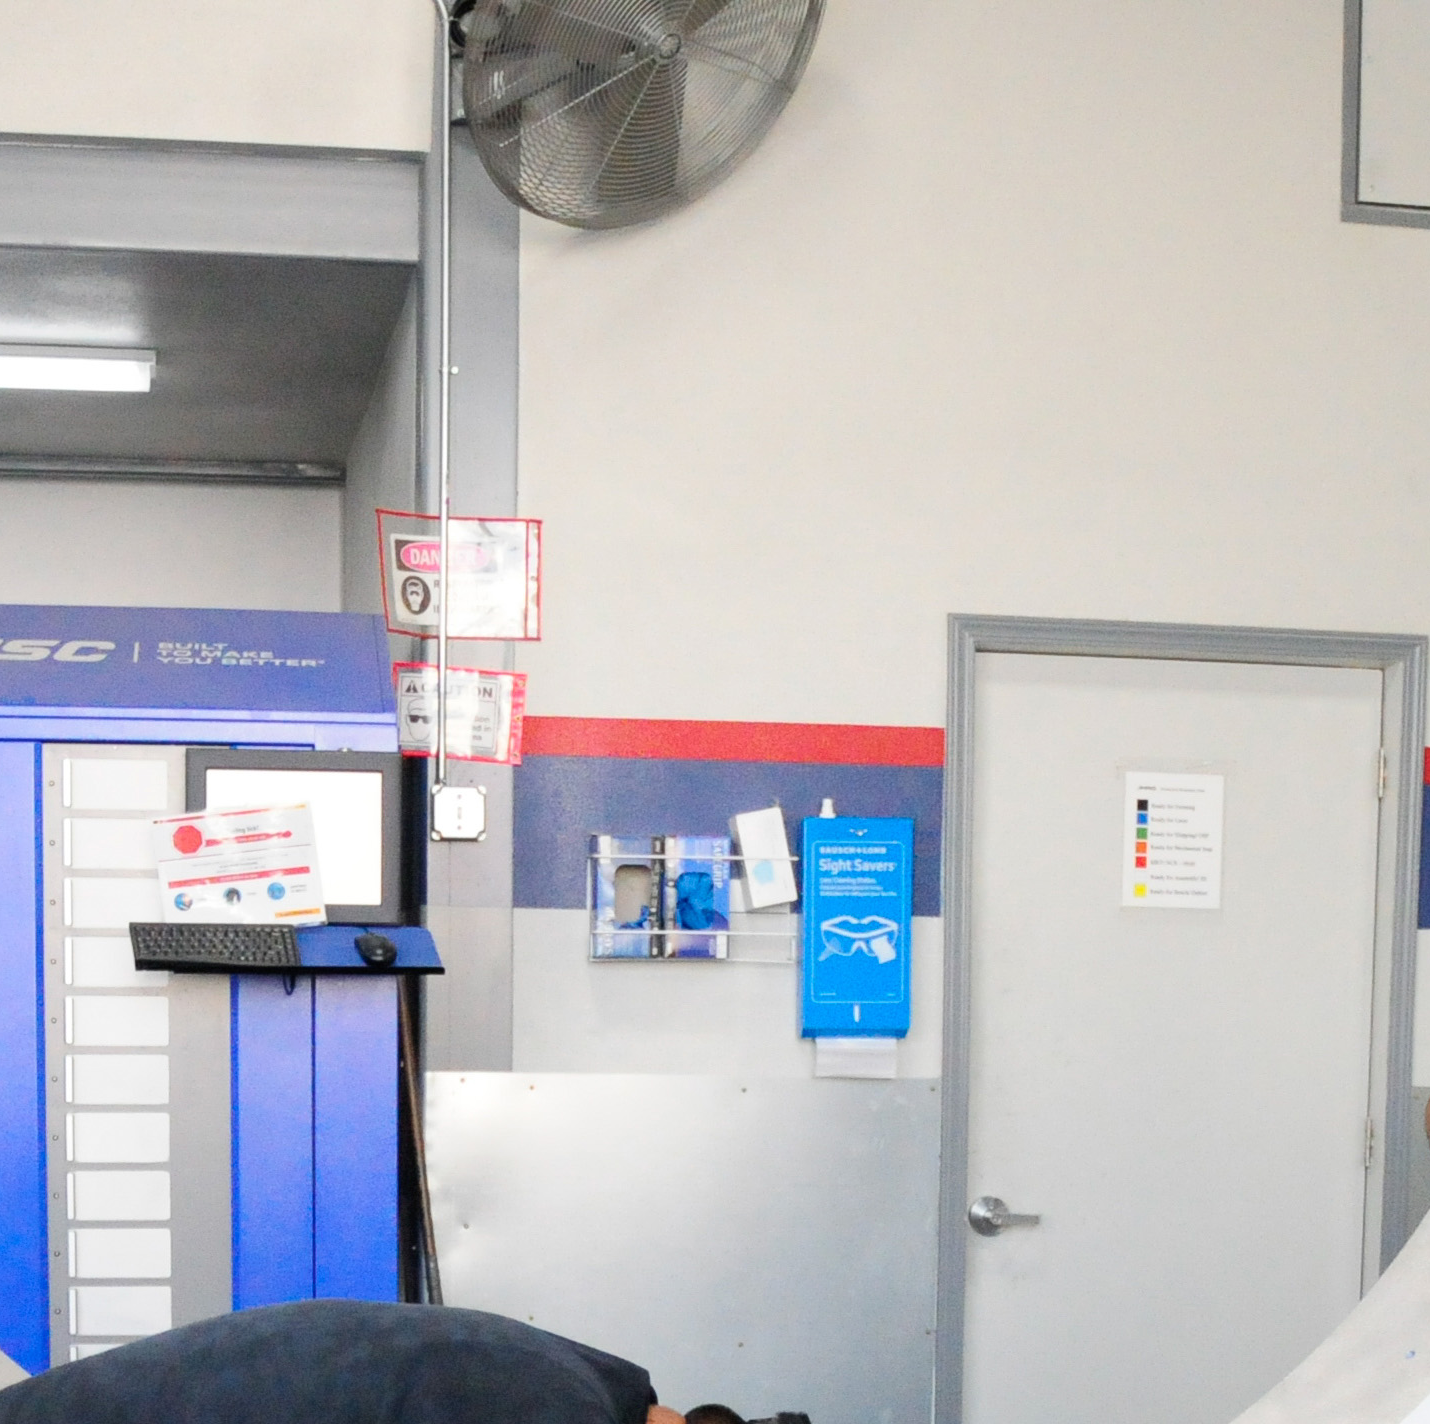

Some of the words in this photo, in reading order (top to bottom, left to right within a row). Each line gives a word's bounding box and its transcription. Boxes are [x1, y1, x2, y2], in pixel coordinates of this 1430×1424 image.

[410, 548, 477, 566] DANER
[158, 642, 228, 650] BUILT
[201, 651, 274, 659] MAKE
[819, 859, 852, 875] Sight
[854, 859, 895, 872] Savers
